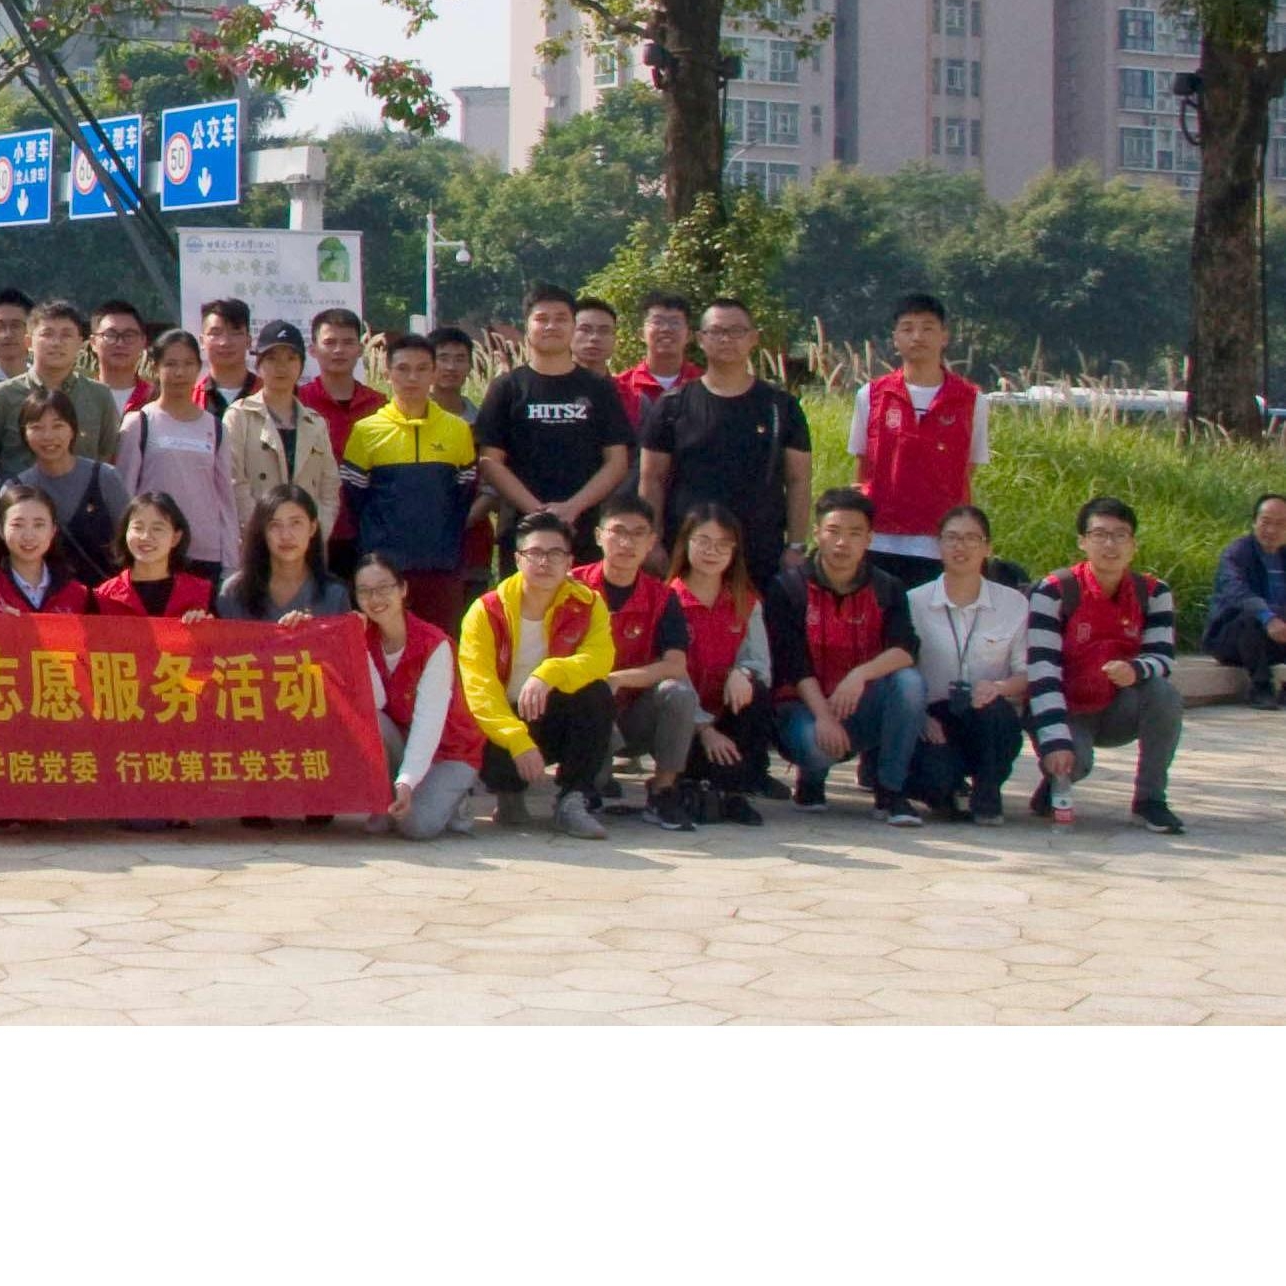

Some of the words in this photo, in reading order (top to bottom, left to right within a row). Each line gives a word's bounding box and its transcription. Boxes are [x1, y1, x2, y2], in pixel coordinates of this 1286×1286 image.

[191, 113, 236, 151] 公交车
[13, 137, 50, 165] 小型车
[527, 403, 588, 420] HITSZ
[116, 748, 330, 783] 行政第五党支部
